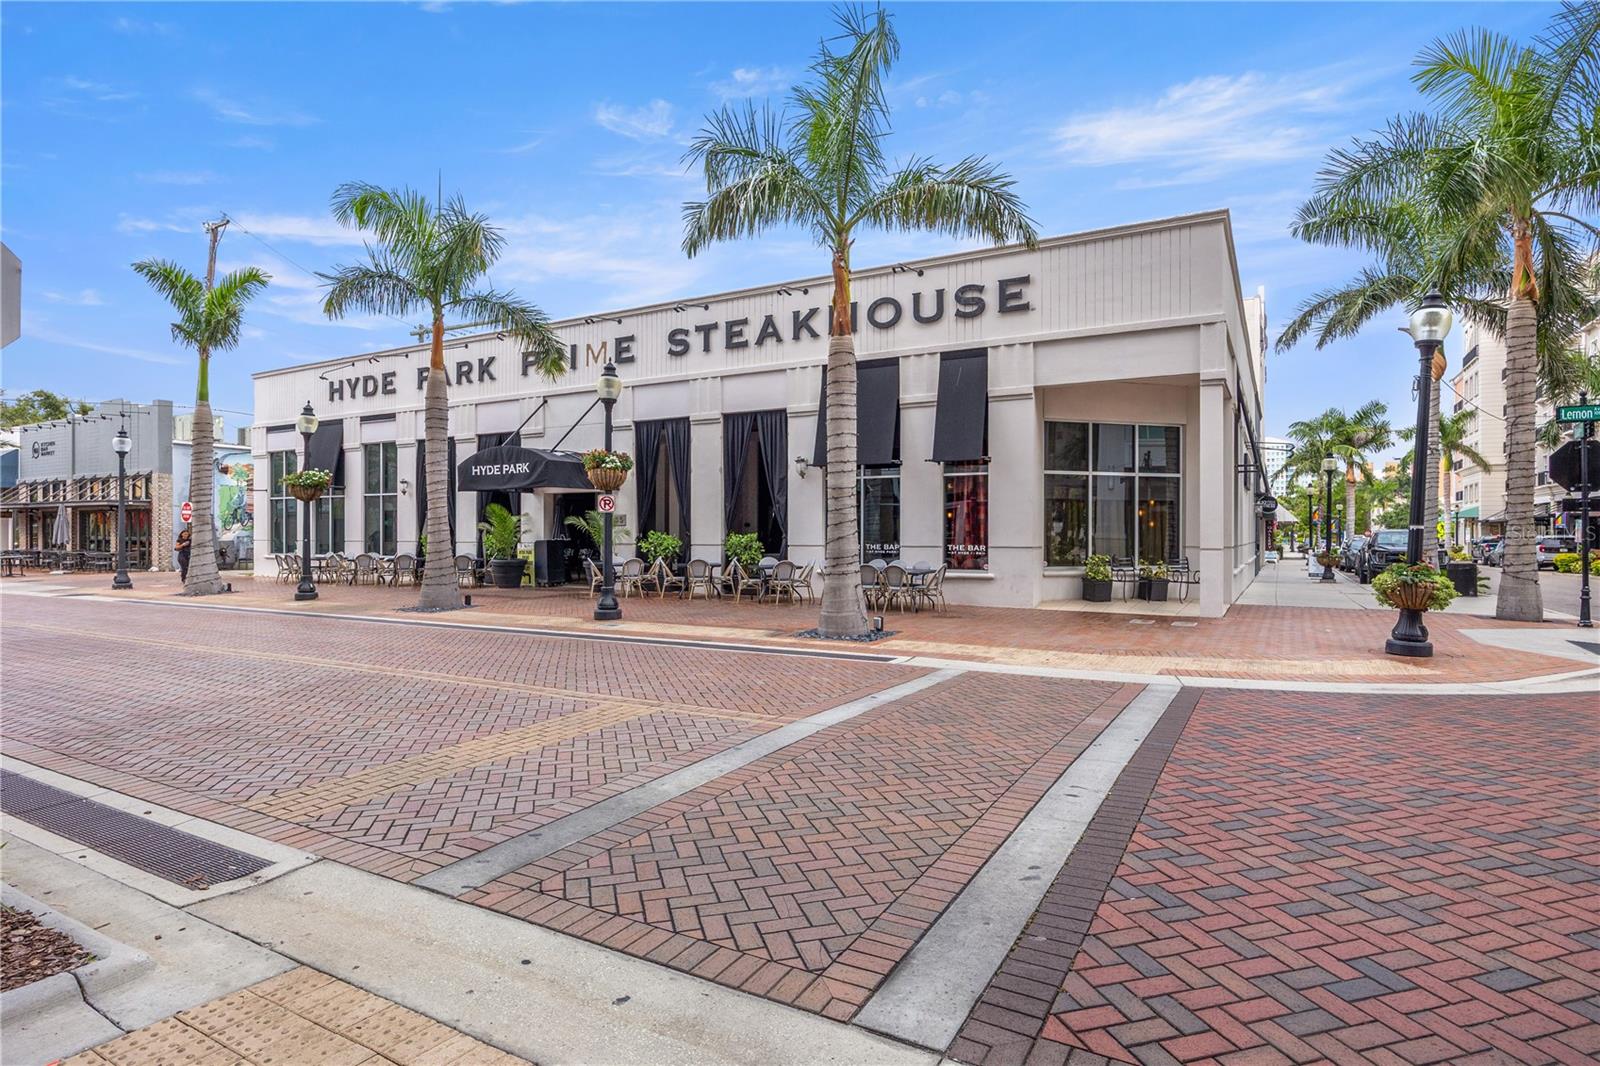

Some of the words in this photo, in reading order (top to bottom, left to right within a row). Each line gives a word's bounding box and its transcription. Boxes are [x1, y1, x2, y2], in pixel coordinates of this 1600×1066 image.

[328, 371, 397, 402] HYDE
[521, 333, 635, 377] PIME
[1561, 408, 1593, 420] Lemon
[471, 464, 501, 476] HYDE
[502, 462, 530, 475] PARK
